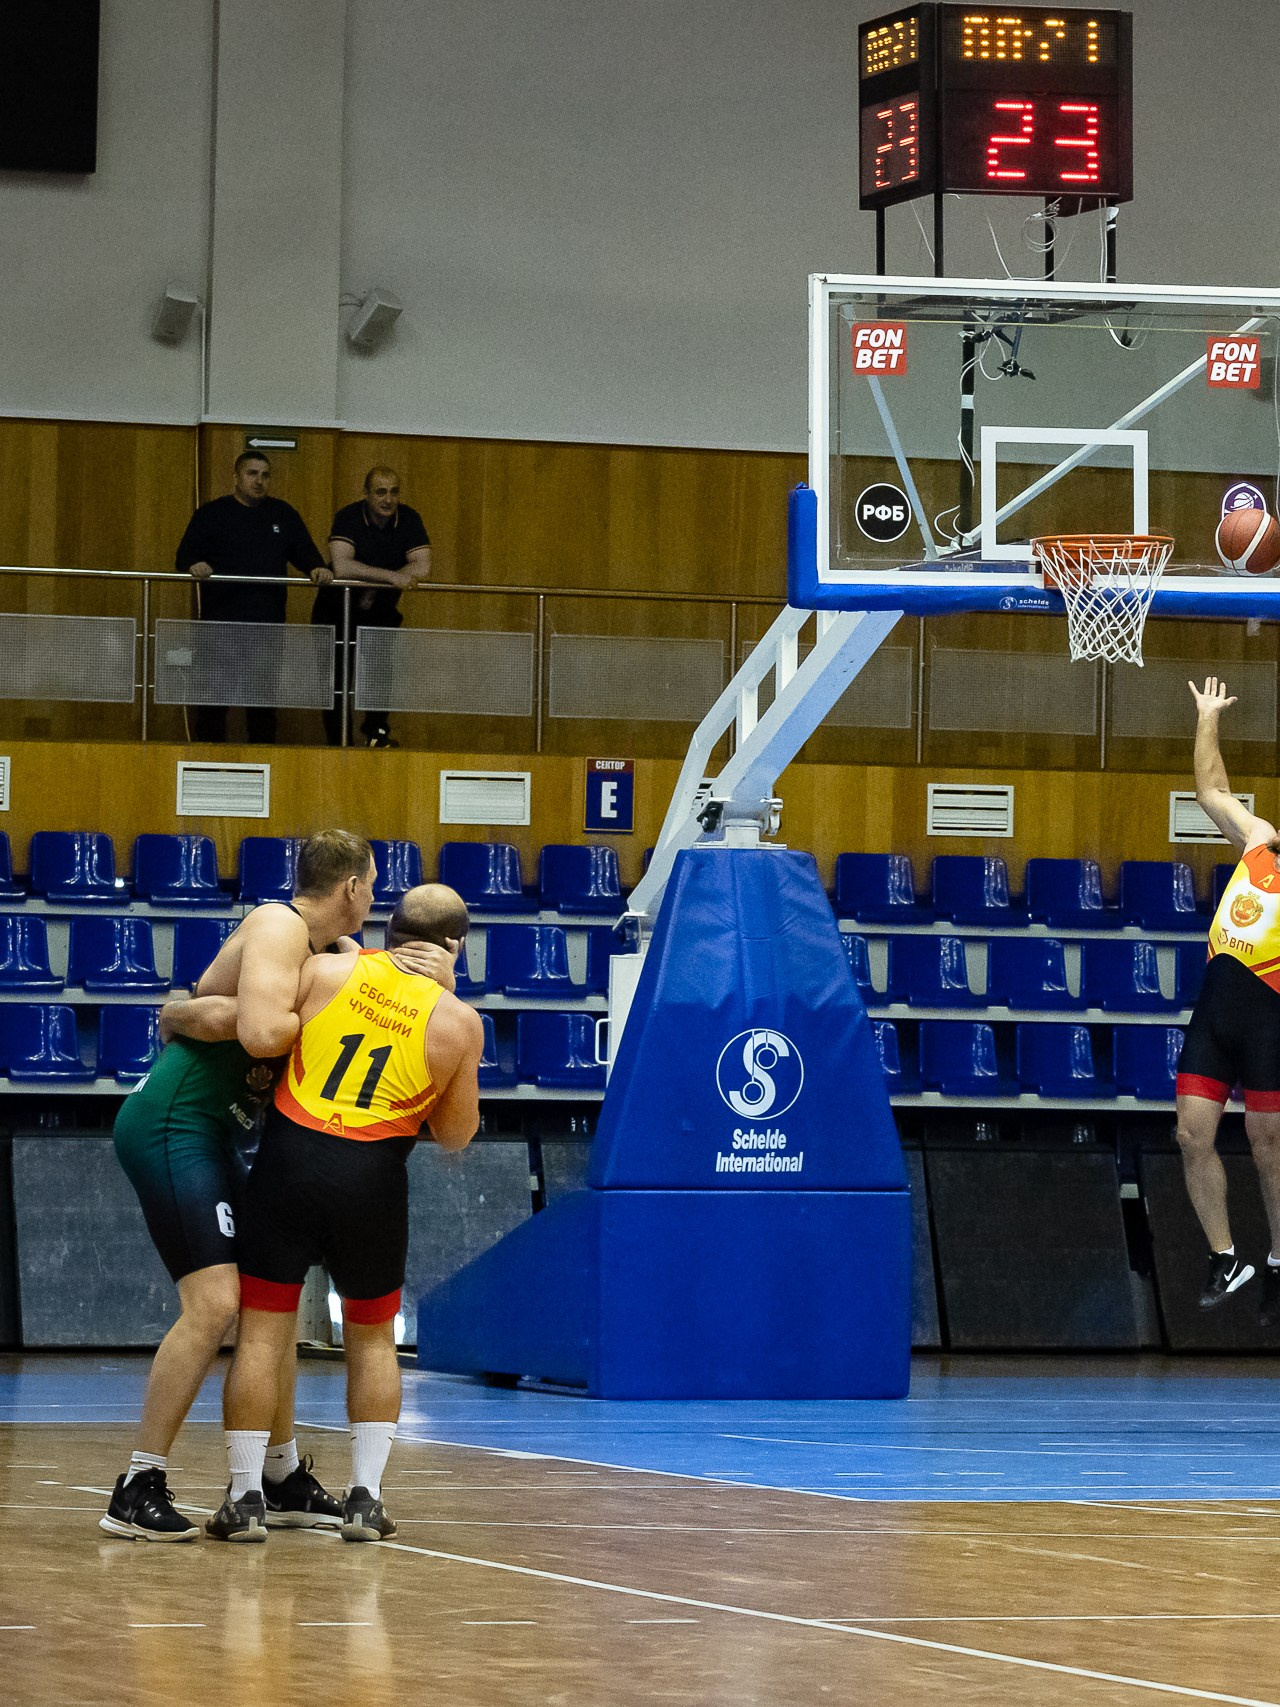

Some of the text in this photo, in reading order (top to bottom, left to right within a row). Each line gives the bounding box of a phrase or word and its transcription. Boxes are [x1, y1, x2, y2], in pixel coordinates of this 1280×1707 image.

[986, 101, 1099, 181] 23
[855, 328, 904, 348] FON
[855, 348, 904, 369] BET
[1210, 342, 1258, 362] FON
[1210, 361, 1258, 383] BET
[862, 504, 905, 521] РФБ
[359, 982, 419, 1020] СБОРНАЯ
[349, 998, 413, 1038] ЧУВАШИИ
[319, 1033, 393, 1110] 11
[732, 1128, 787, 1150] Schelde
[715, 1151, 804, 1173] International
[215, 1201, 236, 1238] 6
